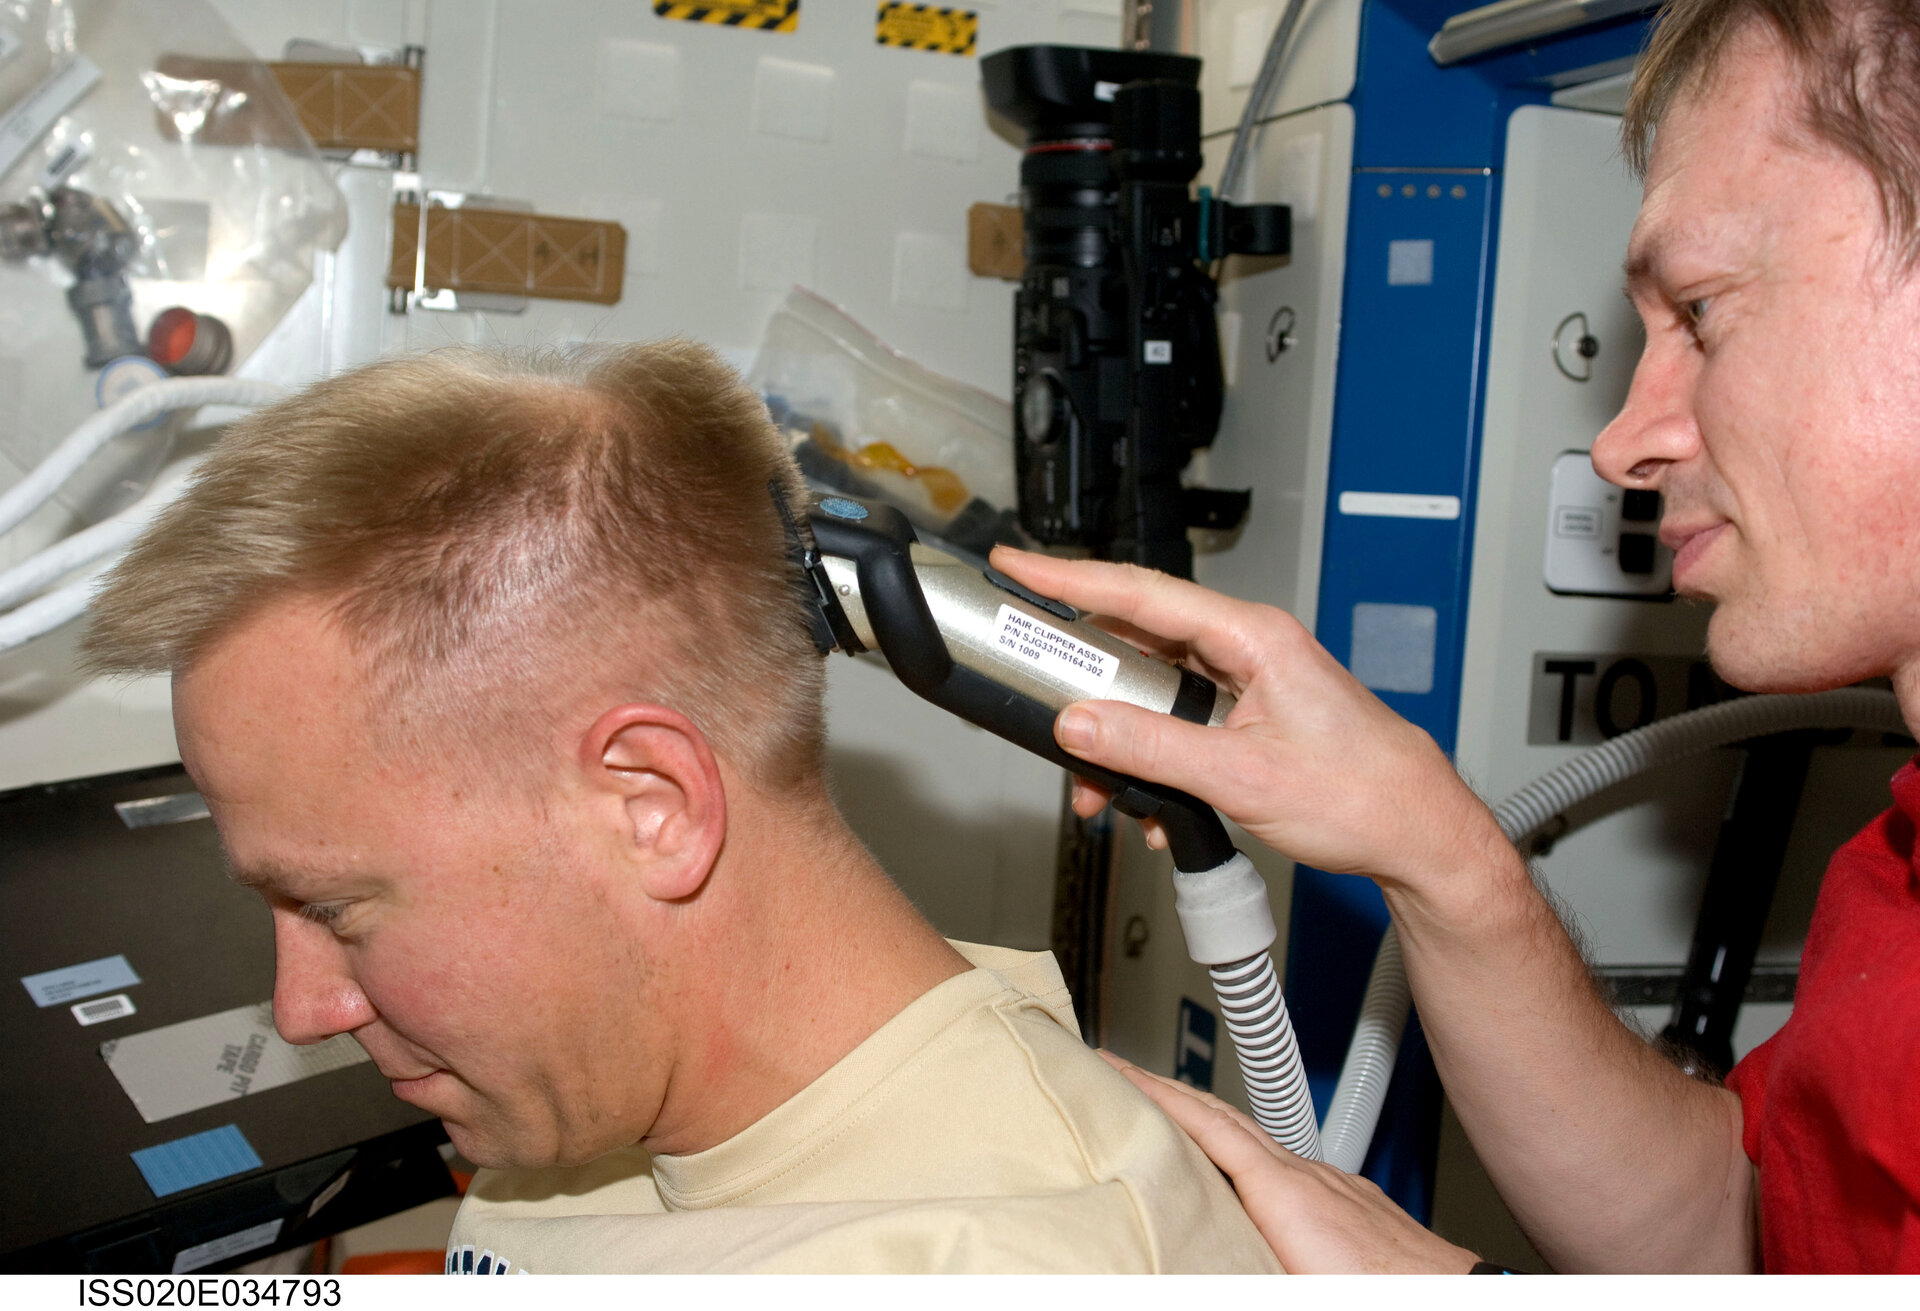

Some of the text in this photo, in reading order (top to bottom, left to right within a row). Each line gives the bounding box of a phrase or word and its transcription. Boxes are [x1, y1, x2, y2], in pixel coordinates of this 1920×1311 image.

[998, 635, 1041, 661] S/N 1009
[1003, 623, 1104, 677] P/N SJG33115164-302
[1007, 613, 1105, 665] HAIR CLIPPER ASSY
[1545, 658, 1657, 741] TO
[216, 1044, 243, 1075] TAPE
[237, 1033, 268, 1076] CARGO
